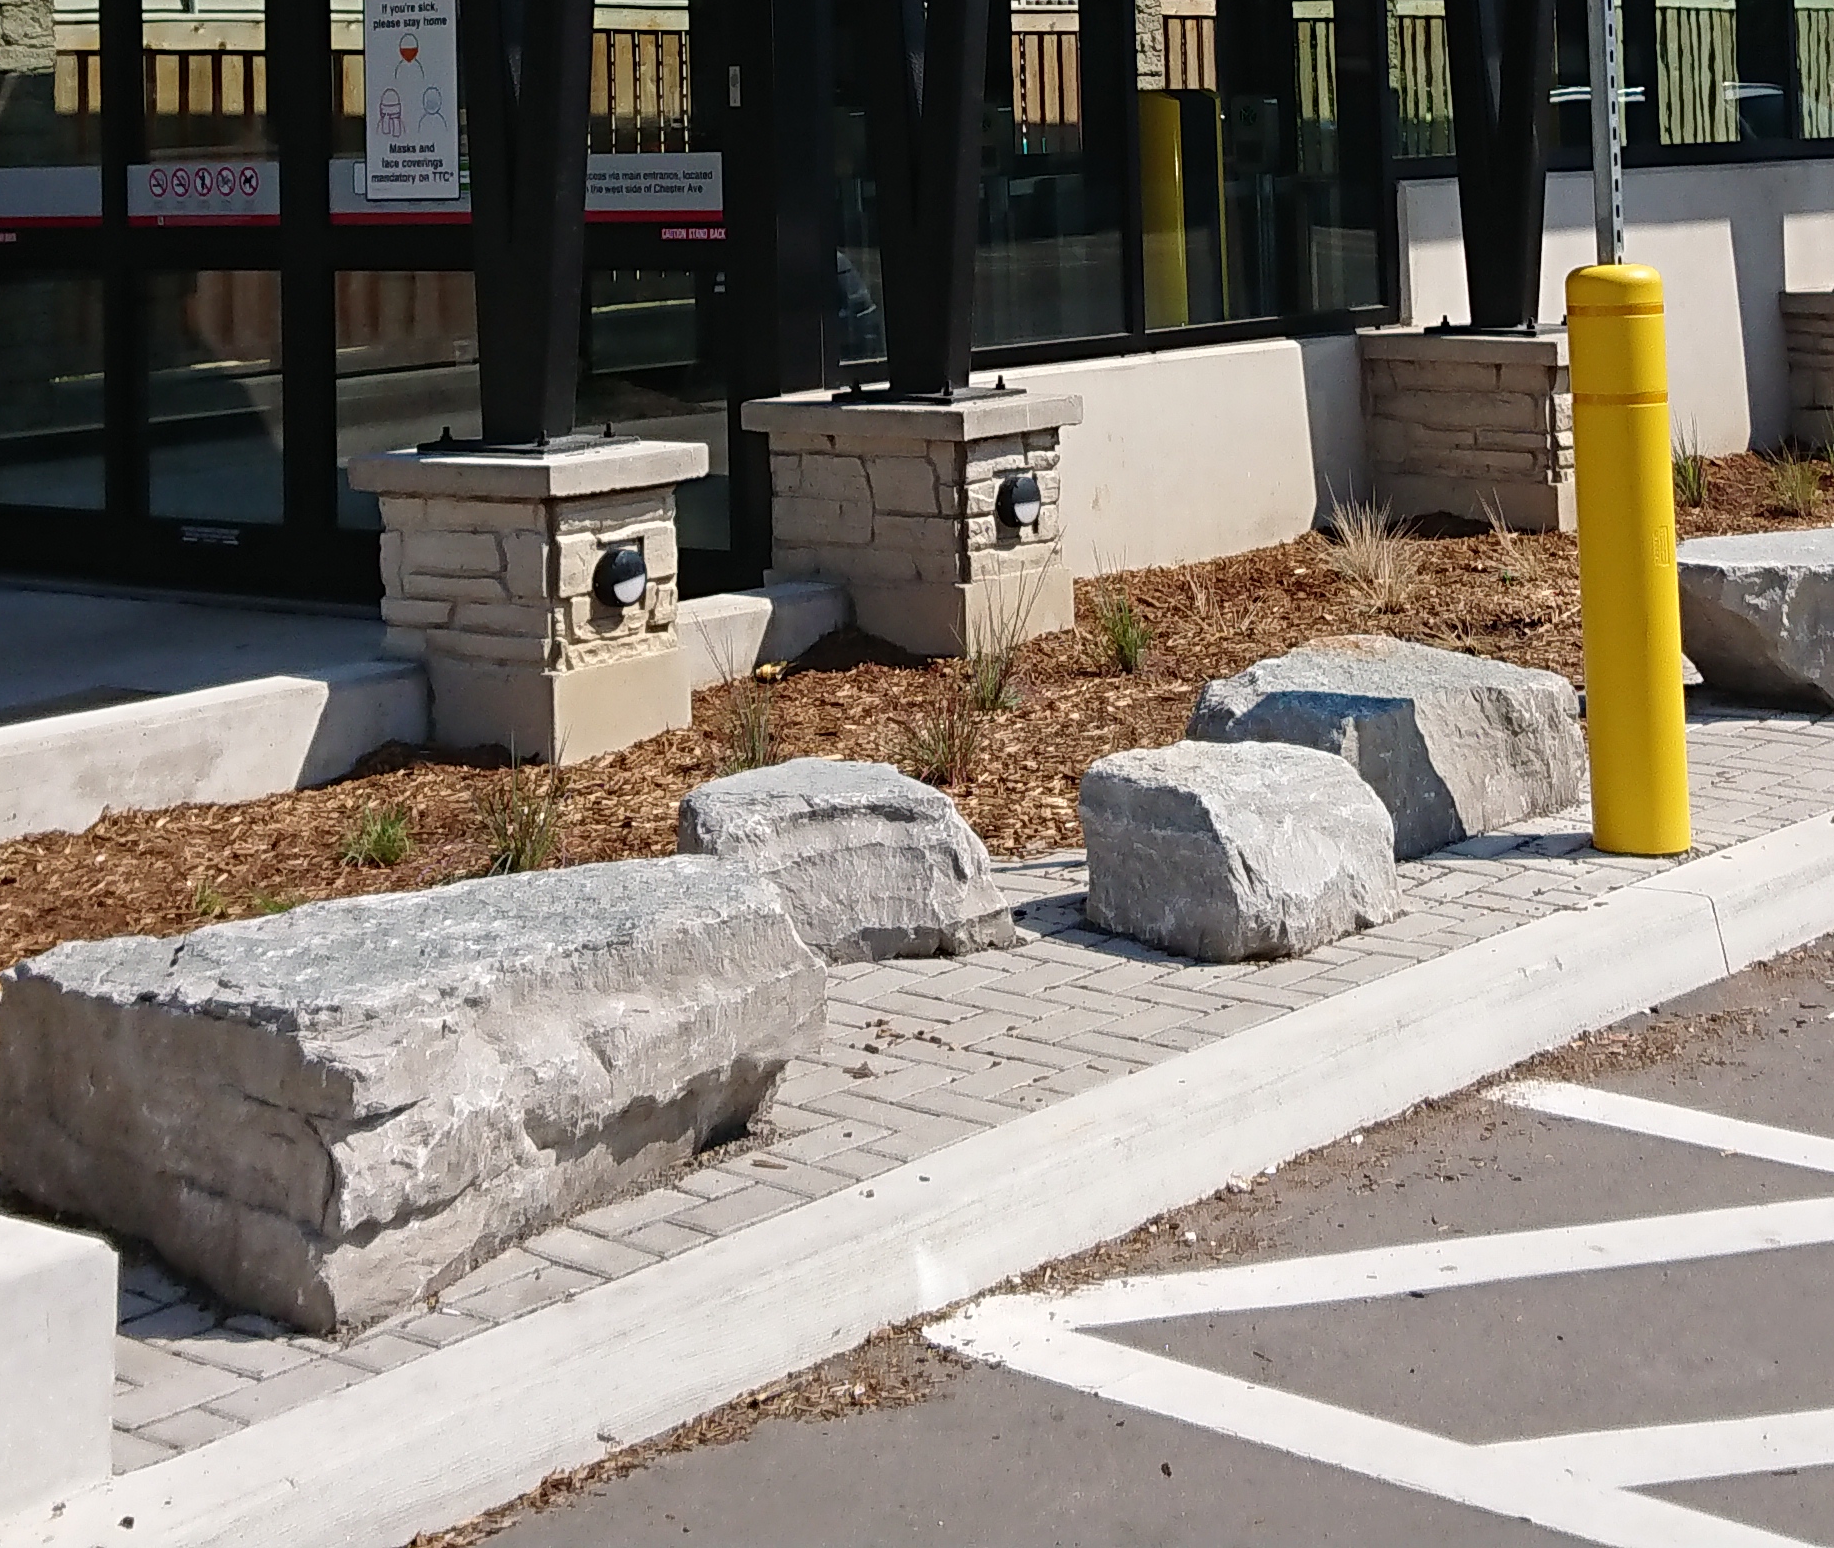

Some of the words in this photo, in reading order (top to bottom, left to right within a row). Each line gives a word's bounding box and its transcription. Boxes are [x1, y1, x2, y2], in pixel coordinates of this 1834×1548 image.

[381, 4, 388, 14] If
[390, 2, 416, 16] you're
[418, 1, 438, 13] sick,
[373, 18, 401, 31] please
[403, 17, 421, 29] stay
[423, 16, 447, 26] home
[389, 143, 416, 153] Masks
[419, 142, 435, 152] and
[382, 157, 399, 168] face
[402, 157, 443, 169] coverings
[371, 172, 416, 184] mandatory
[419, 173, 429, 182] on
[608, 171, 620, 181] via
[622, 171, 641, 180] main
[683, 171, 713, 180] located
[590, 183, 603, 193] the
[605, 184, 623, 194] west
[625, 183, 642, 193] side
[644, 183, 652, 193] of
[653, 183, 685, 194] Chester
[687, 183, 703, 193] Ave
[661, 228, 687, 239] CAUTION
[709, 228, 726, 239] BACK
